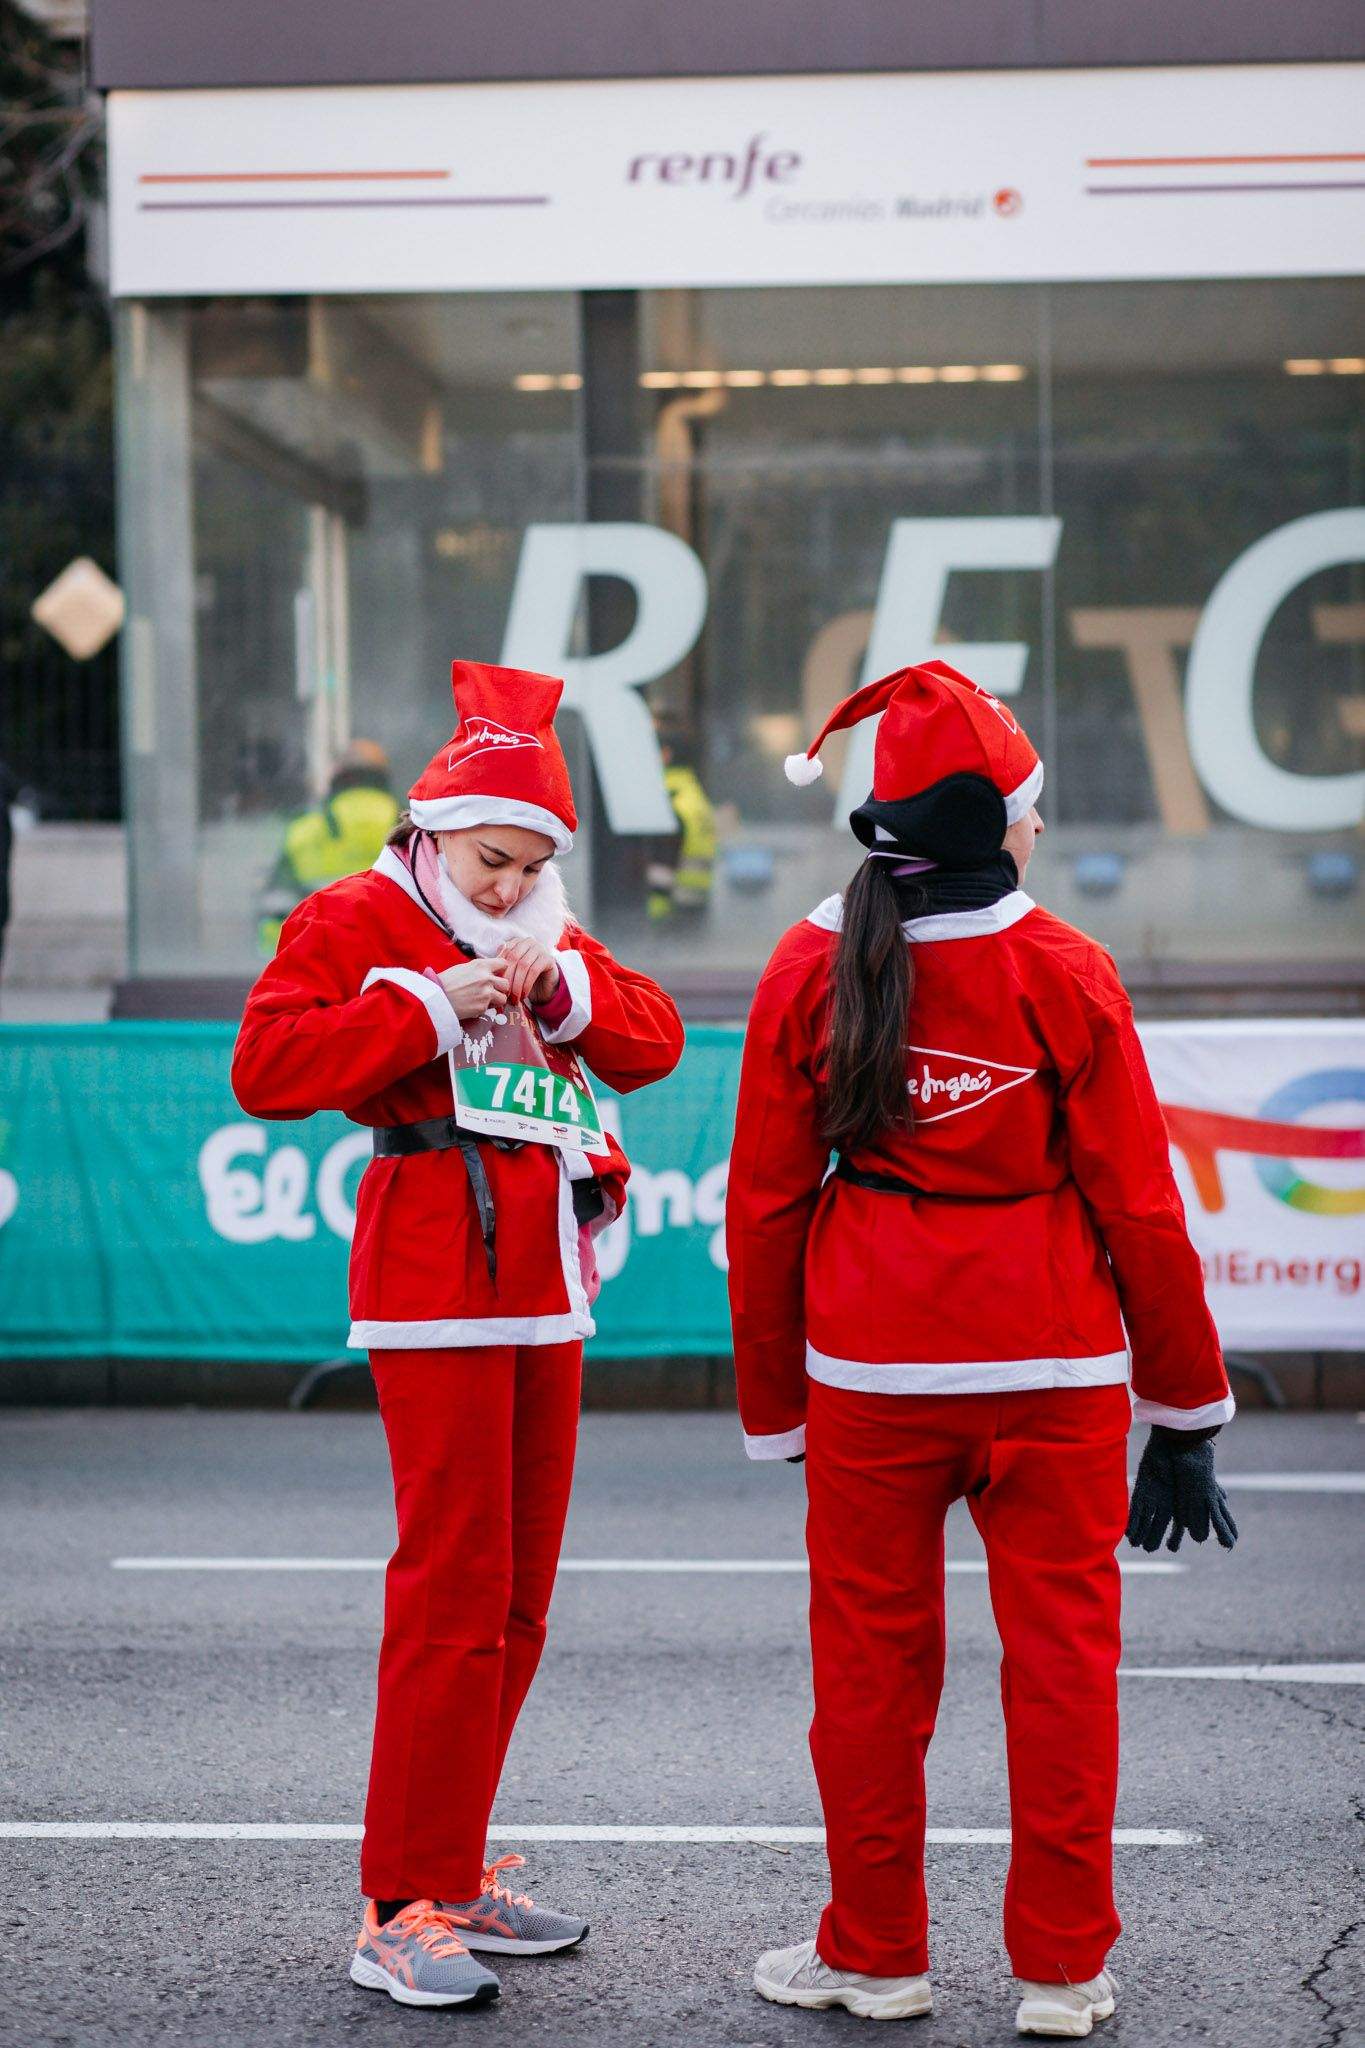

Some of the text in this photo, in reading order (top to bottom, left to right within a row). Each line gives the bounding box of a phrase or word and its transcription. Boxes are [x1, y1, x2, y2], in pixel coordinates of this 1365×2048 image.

[627, 132, 802, 199] renfe
[897, 194, 984, 219] Madrid
[486, 1067, 581, 1122] 7414
[921, 1065, 992, 1104] Inglés
[199, 1122, 317, 1244] El
